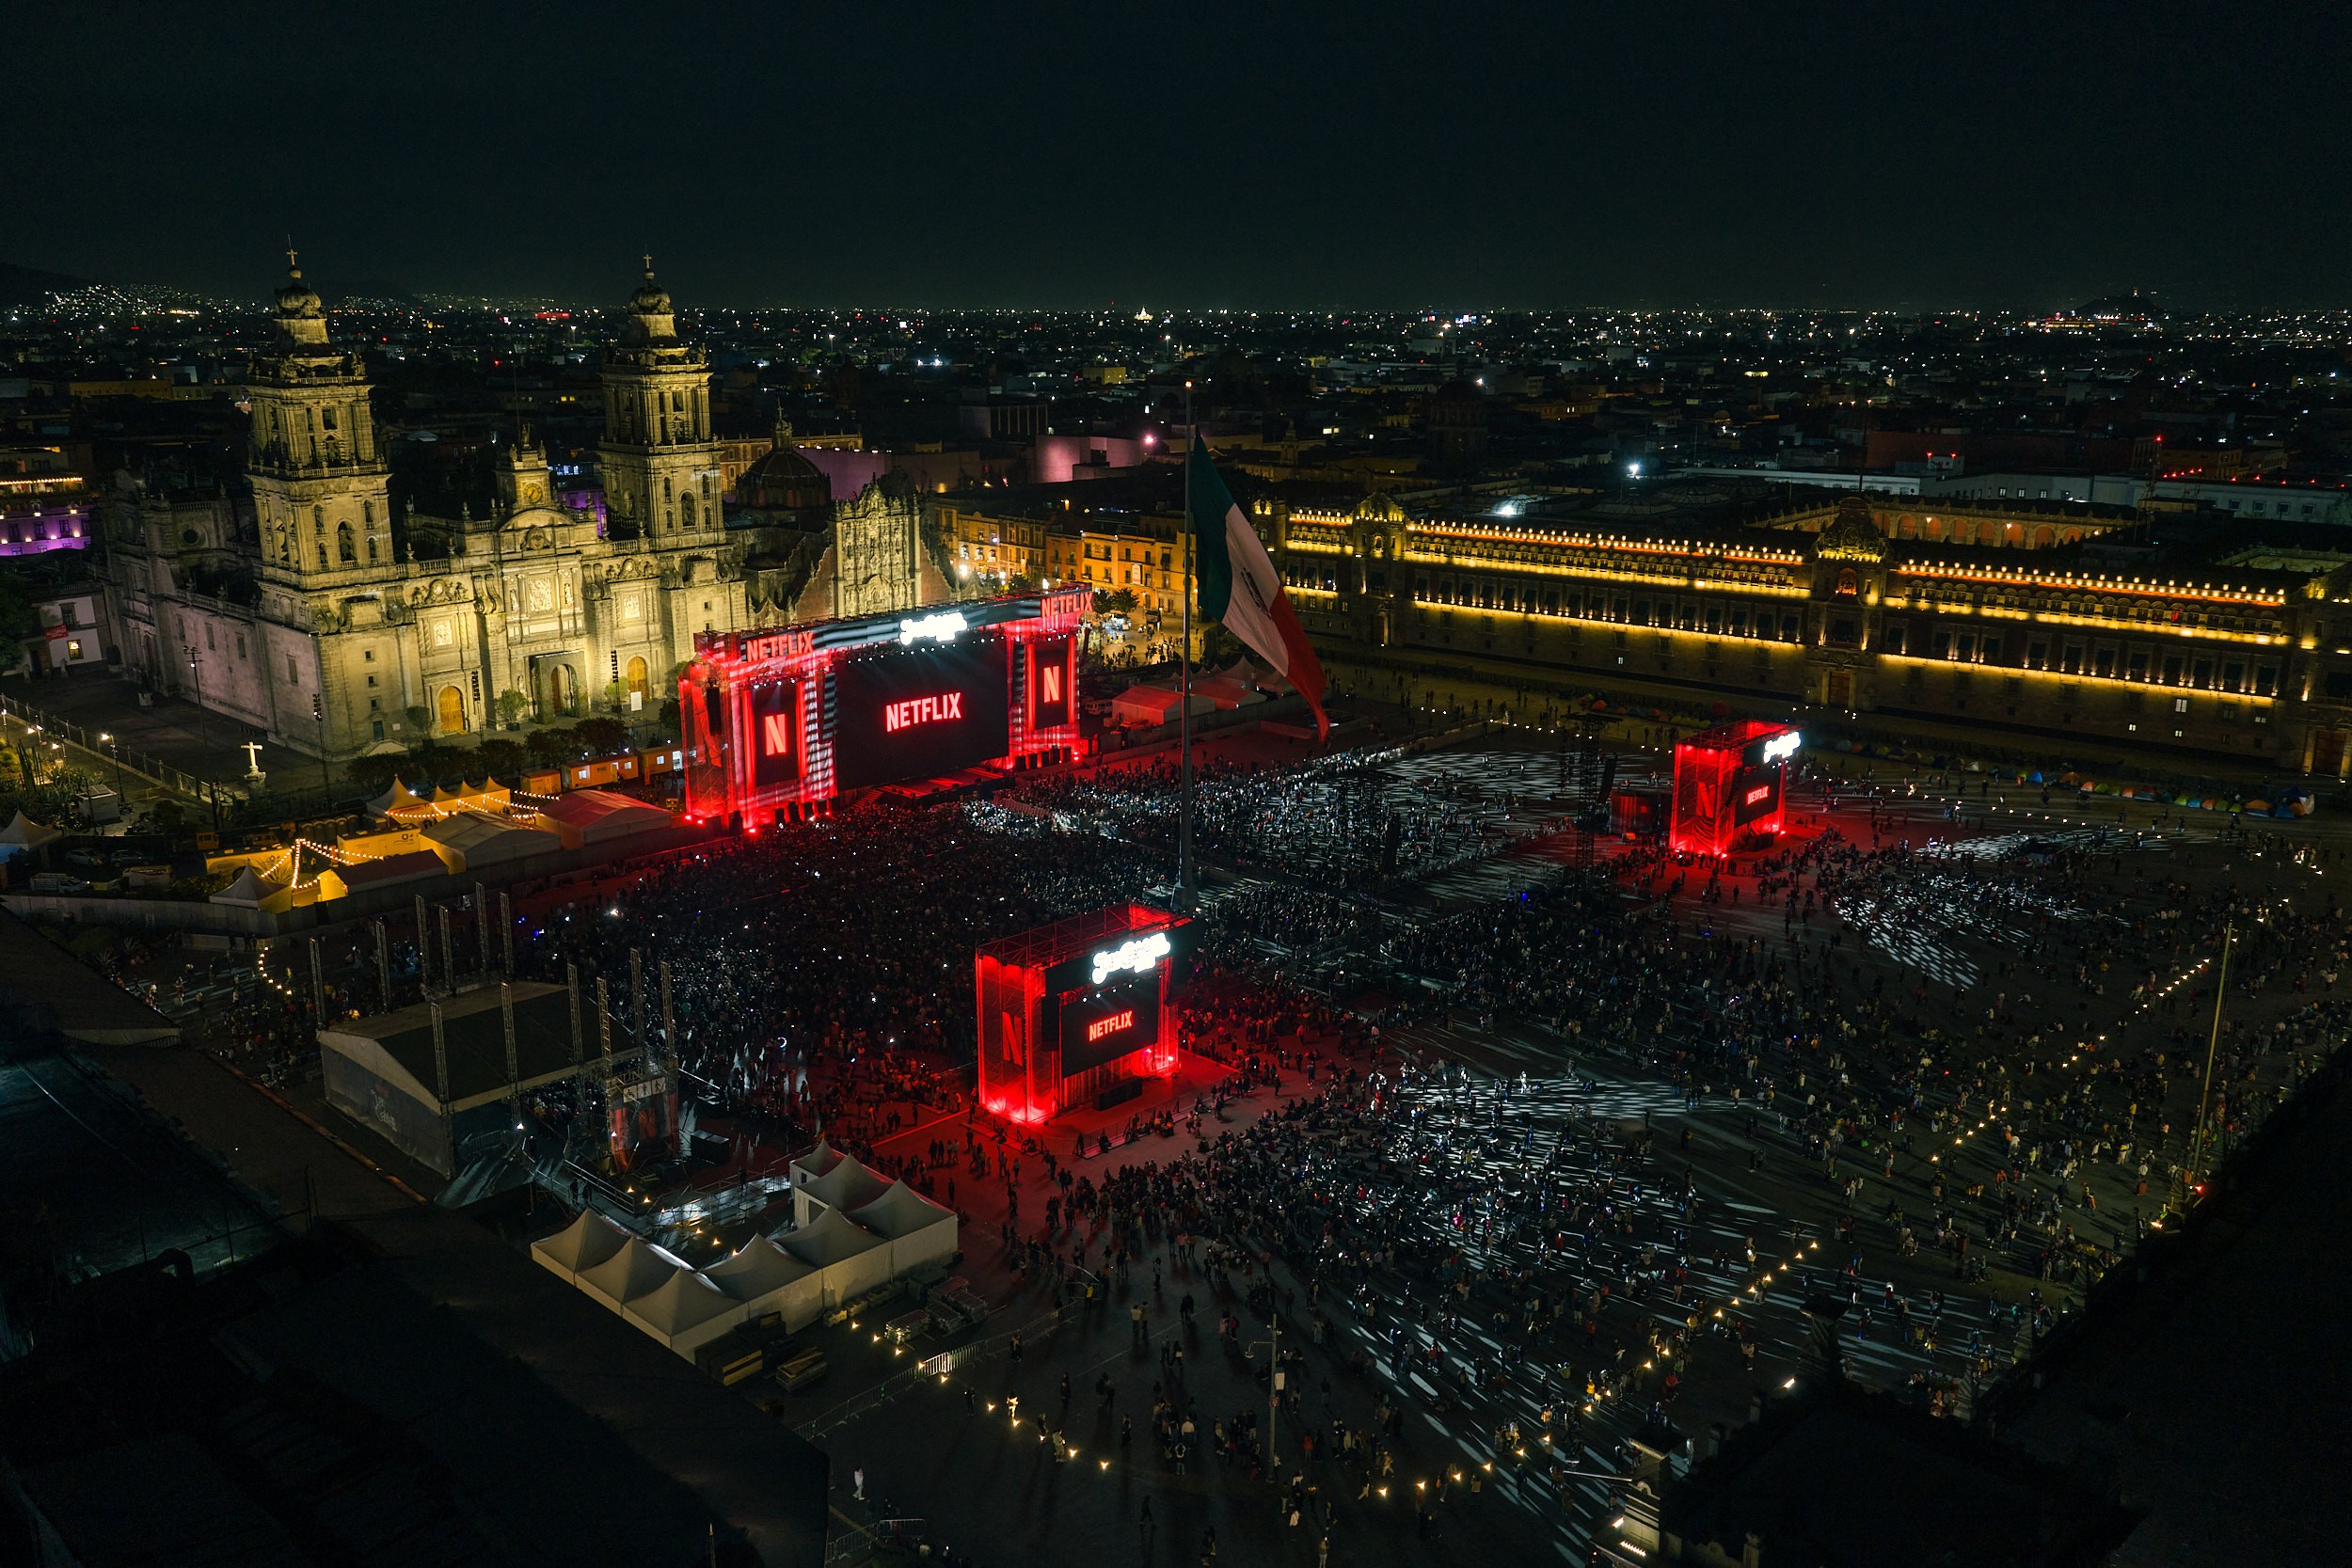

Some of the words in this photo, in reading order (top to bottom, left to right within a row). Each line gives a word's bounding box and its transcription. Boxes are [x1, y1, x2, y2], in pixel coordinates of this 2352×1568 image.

[1041, 592, 1093, 619] NETFLIX
[746, 631, 813, 661] NETFLIX
[1043, 665, 1059, 704] N
[885, 691, 961, 733] NETFLIX
[764, 713, 787, 756] N
[1747, 785, 1770, 806] NETFLIX
[1002, 1011, 1024, 1068] N
[1089, 1010, 1133, 1042] NETFLIX
